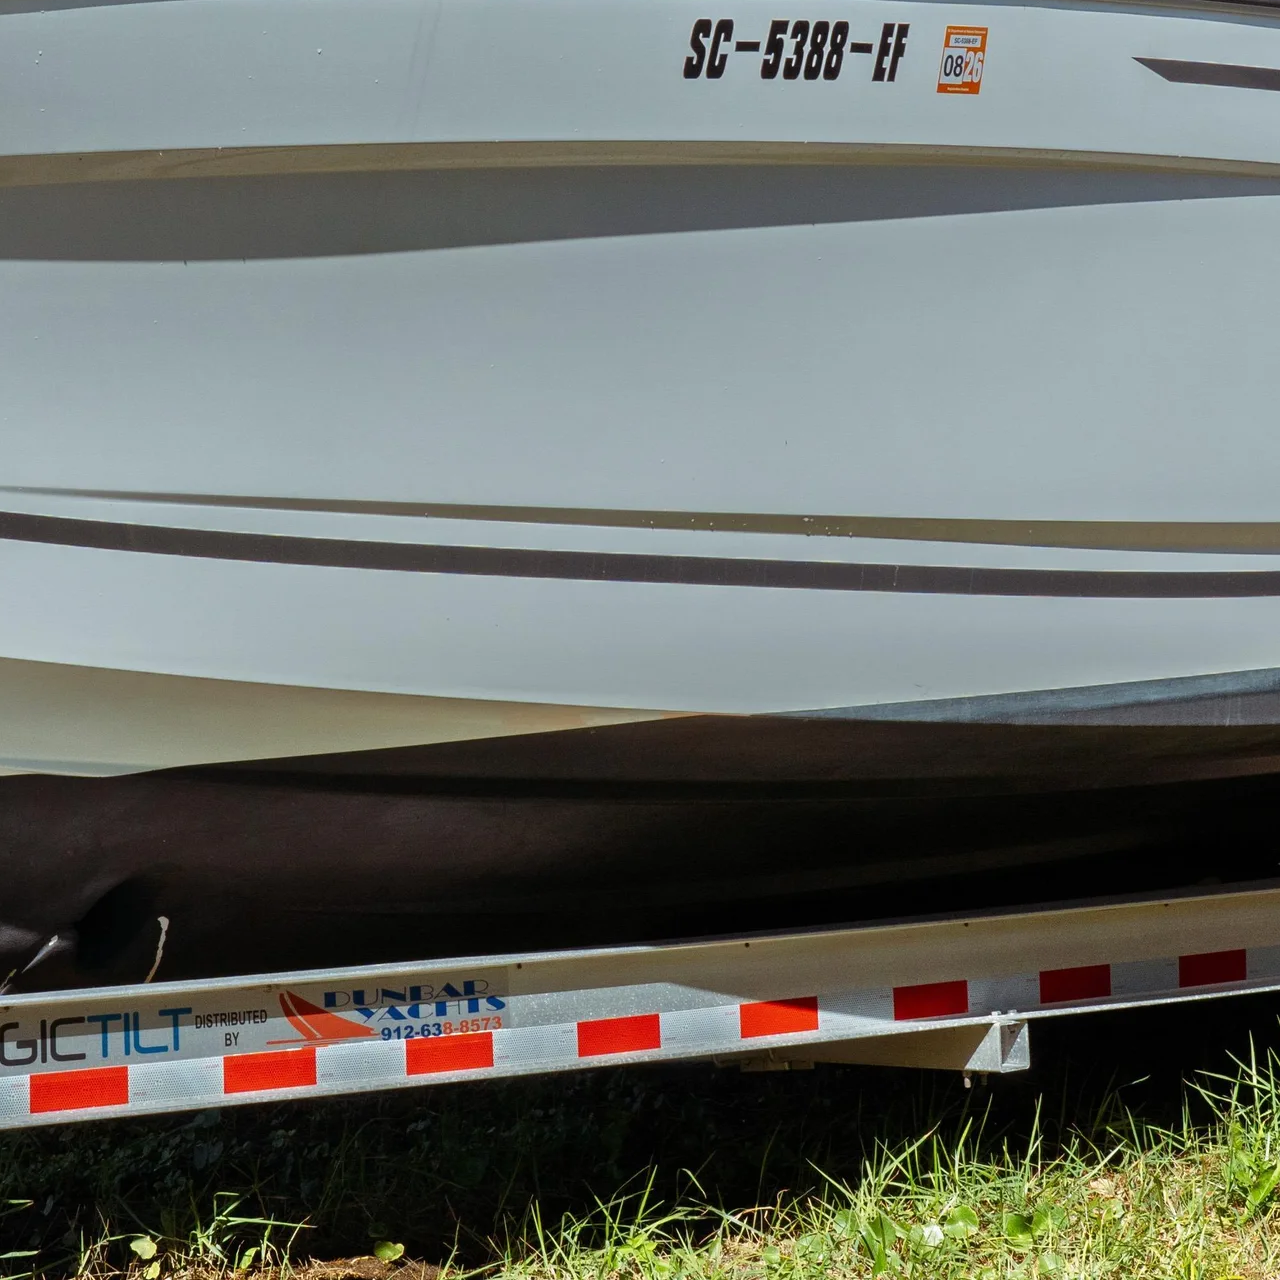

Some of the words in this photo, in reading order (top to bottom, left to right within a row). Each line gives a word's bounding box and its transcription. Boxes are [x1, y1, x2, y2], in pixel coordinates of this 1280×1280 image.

[683, 18, 911, 82] SC-5388-EF
[943, 54, 964, 77] 08
[323, 979, 490, 1008] DUNBAR
[195, 1009, 268, 1030] DISTRIBUTED
[354, 994, 506, 1024] YACHTS
[223, 1032, 240, 1047] BY
[381, 1016, 503, 1042] 912-638-8573
